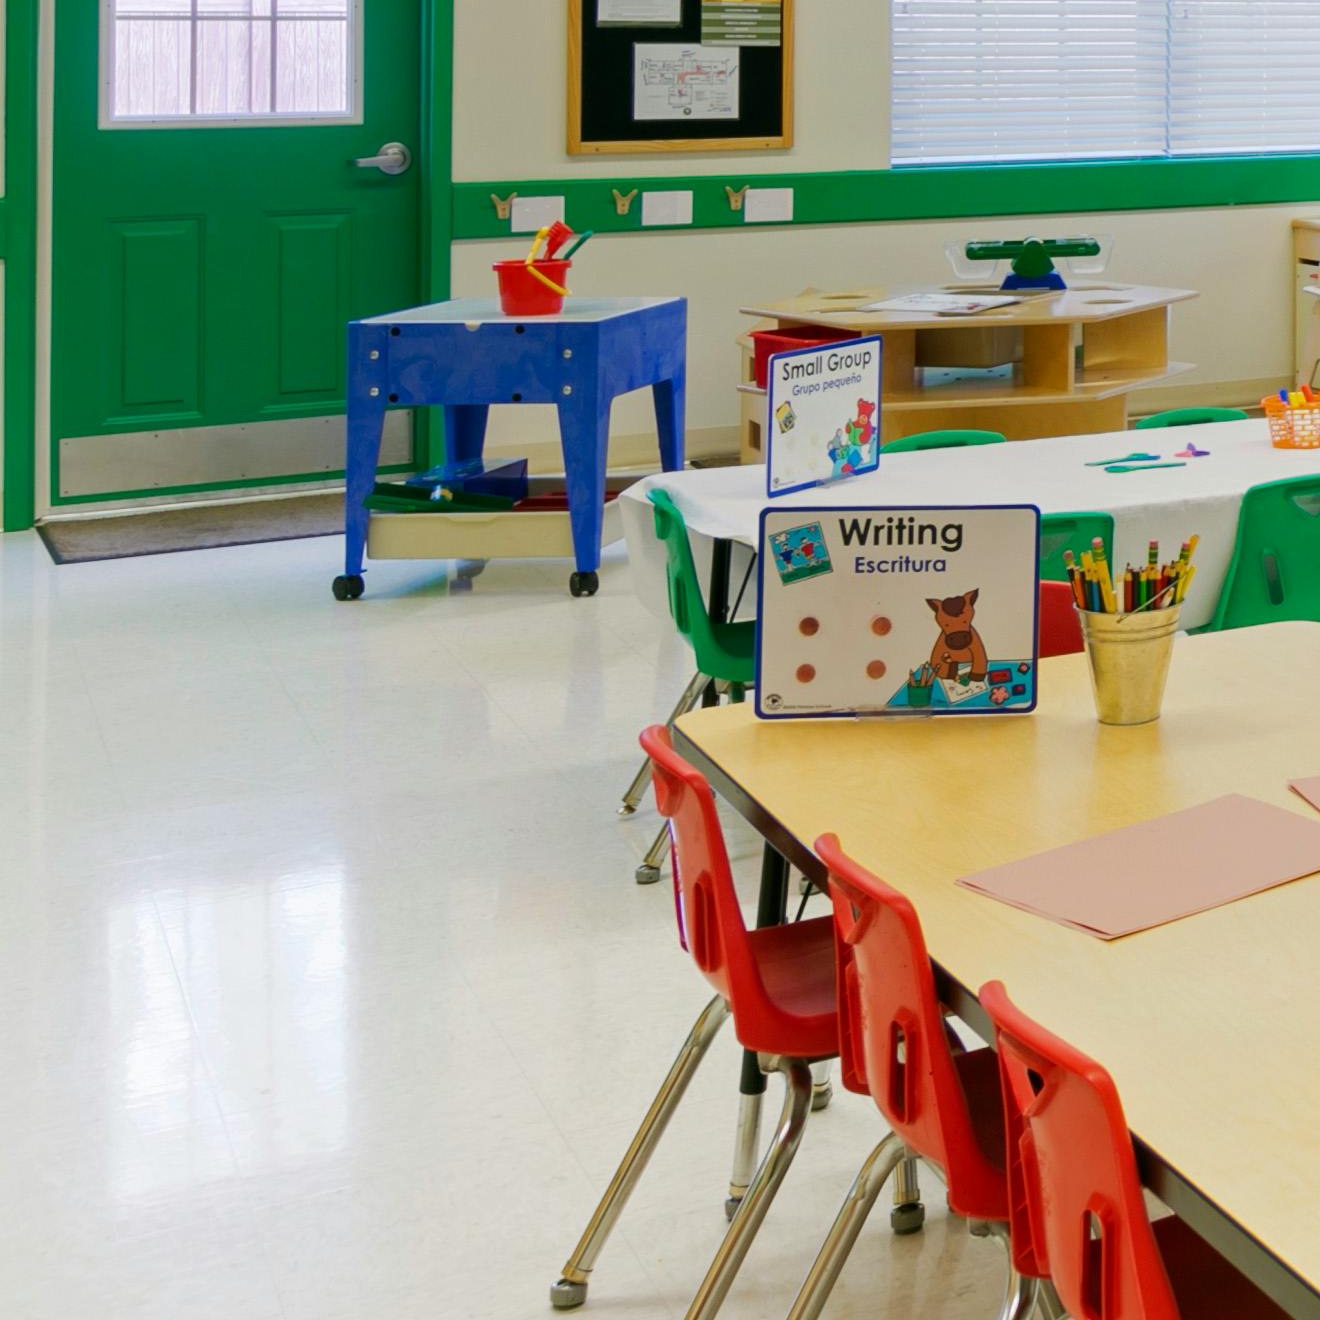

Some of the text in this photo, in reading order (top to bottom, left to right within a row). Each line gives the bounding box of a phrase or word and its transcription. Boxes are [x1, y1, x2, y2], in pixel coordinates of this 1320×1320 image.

[782, 350, 872, 382] Small Group
[792, 372, 862, 396] Grupo pequeño
[838, 516, 964, 552] Writing
[854, 555, 947, 574] Escritura
